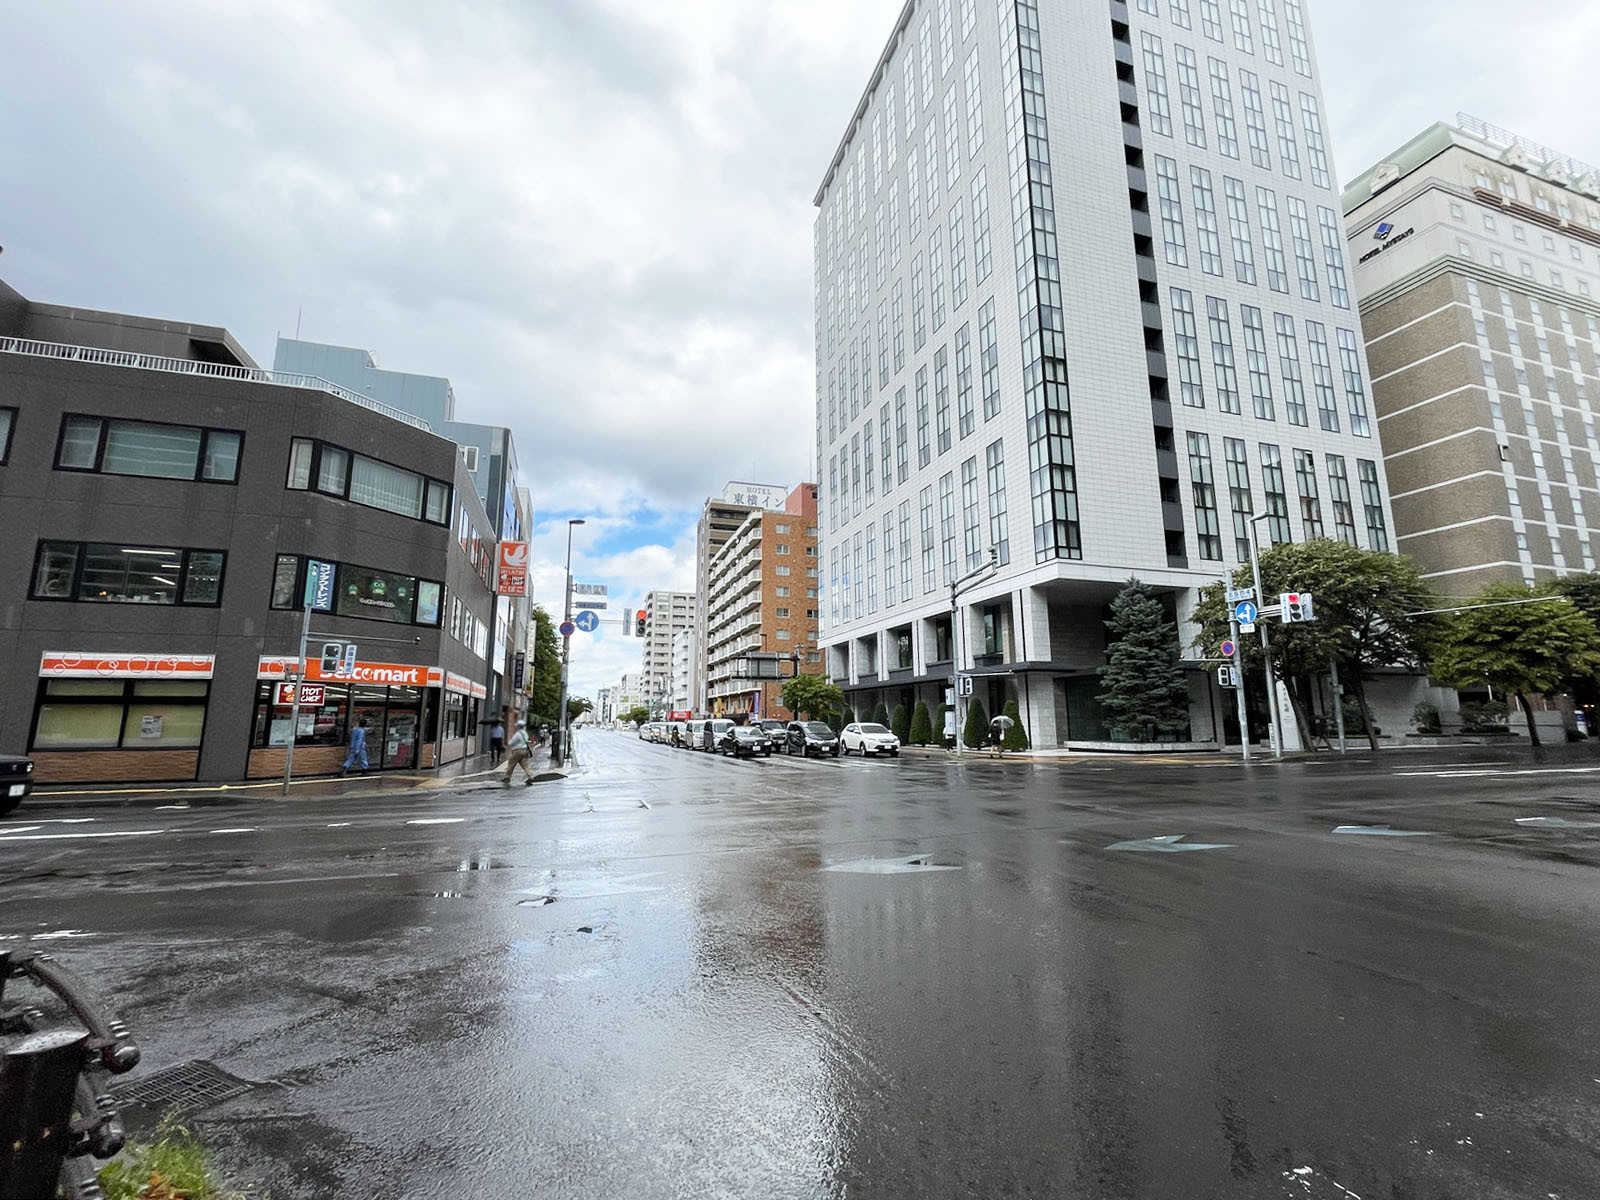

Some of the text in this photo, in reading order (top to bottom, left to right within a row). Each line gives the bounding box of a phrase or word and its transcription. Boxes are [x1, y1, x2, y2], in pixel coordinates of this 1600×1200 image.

[746, 486, 771, 495] HOTEL
[733, 492, 784, 508] 東横イン
[301, 686, 323, 696] HOT
